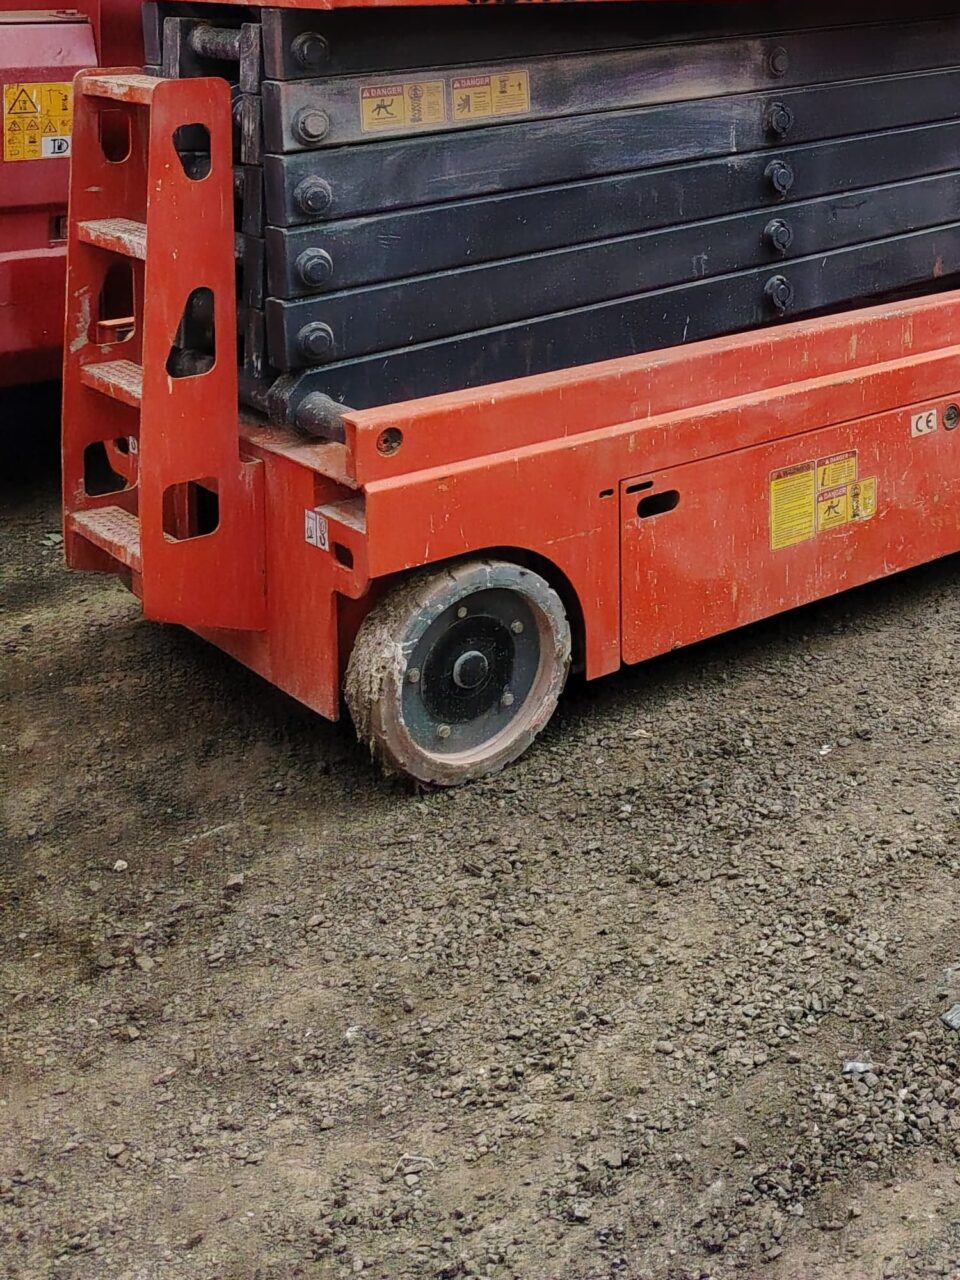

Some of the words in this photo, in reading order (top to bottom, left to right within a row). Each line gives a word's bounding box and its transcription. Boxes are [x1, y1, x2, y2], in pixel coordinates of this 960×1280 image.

[461, 77, 489, 88] DANGER
[371, 86, 402, 97] DANGER
[916, 412, 933, 432] CE
